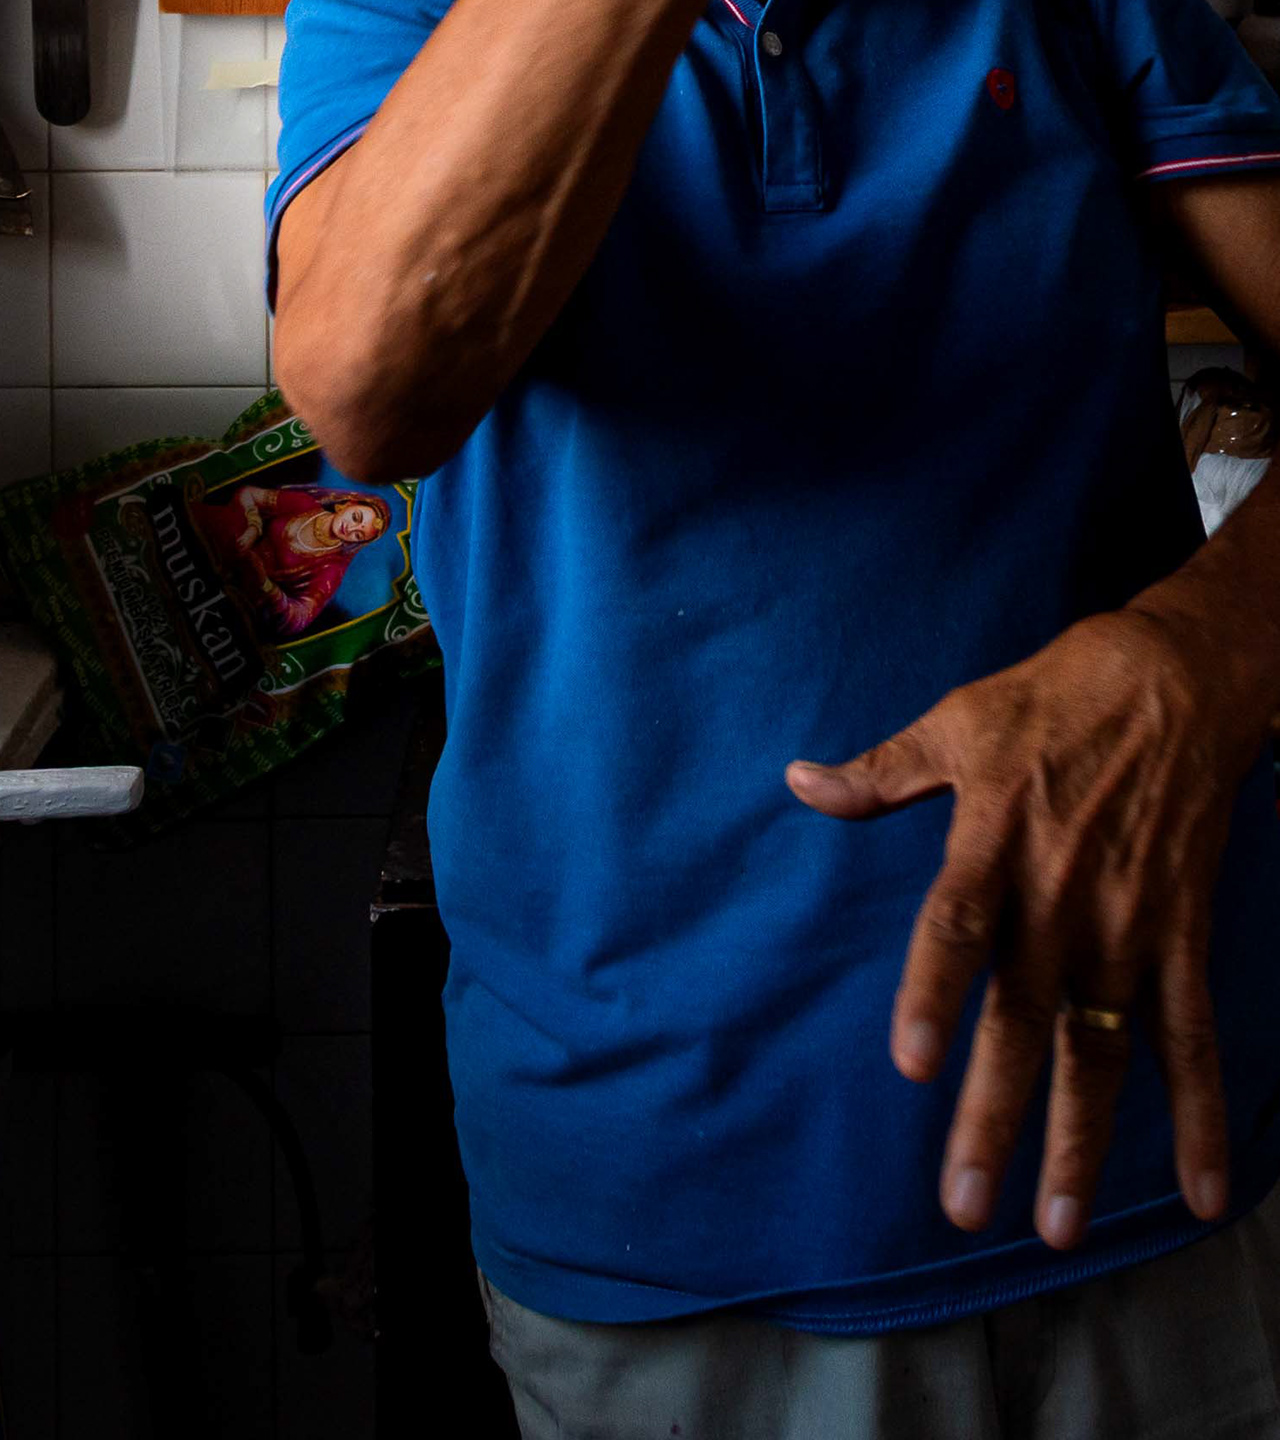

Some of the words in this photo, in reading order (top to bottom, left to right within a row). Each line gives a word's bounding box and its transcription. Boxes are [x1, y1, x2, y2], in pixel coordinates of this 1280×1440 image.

[96, 527, 137, 606] PREMIUM
[129, 604, 166, 682] BASMATI
[157, 679, 183, 721] RICE
[150, 503, 249, 683] muskan
